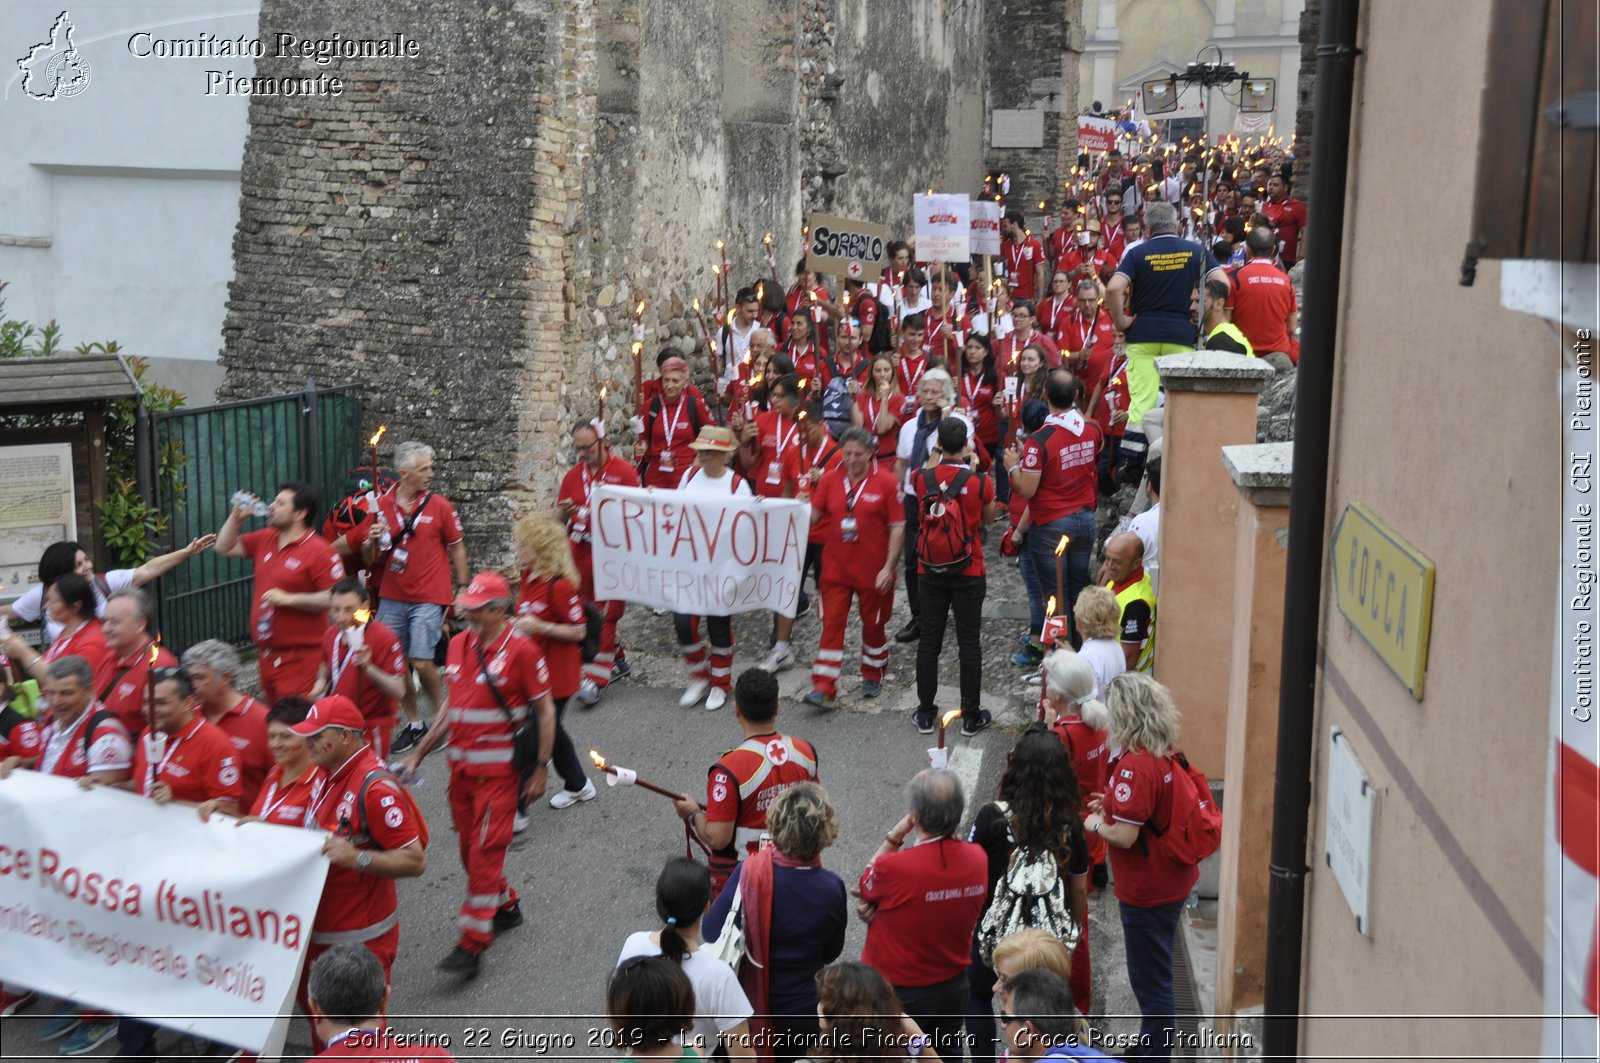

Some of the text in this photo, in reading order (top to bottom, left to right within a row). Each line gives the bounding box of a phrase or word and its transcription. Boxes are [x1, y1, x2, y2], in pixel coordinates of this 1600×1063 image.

[812, 226, 883, 263] SORBOLO
[598, 497, 657, 556] CRI
[670, 504, 801, 571] AVOLA
[601, 559, 797, 610] SOLFERINO 2019
[1348, 536, 1408, 653] ROCCA
[38, 847, 143, 918] Rossa
[154, 878, 302, 951] Italiana
[65, 918, 189, 980] Regionale
[195, 952, 267, 1003] Sicilia
